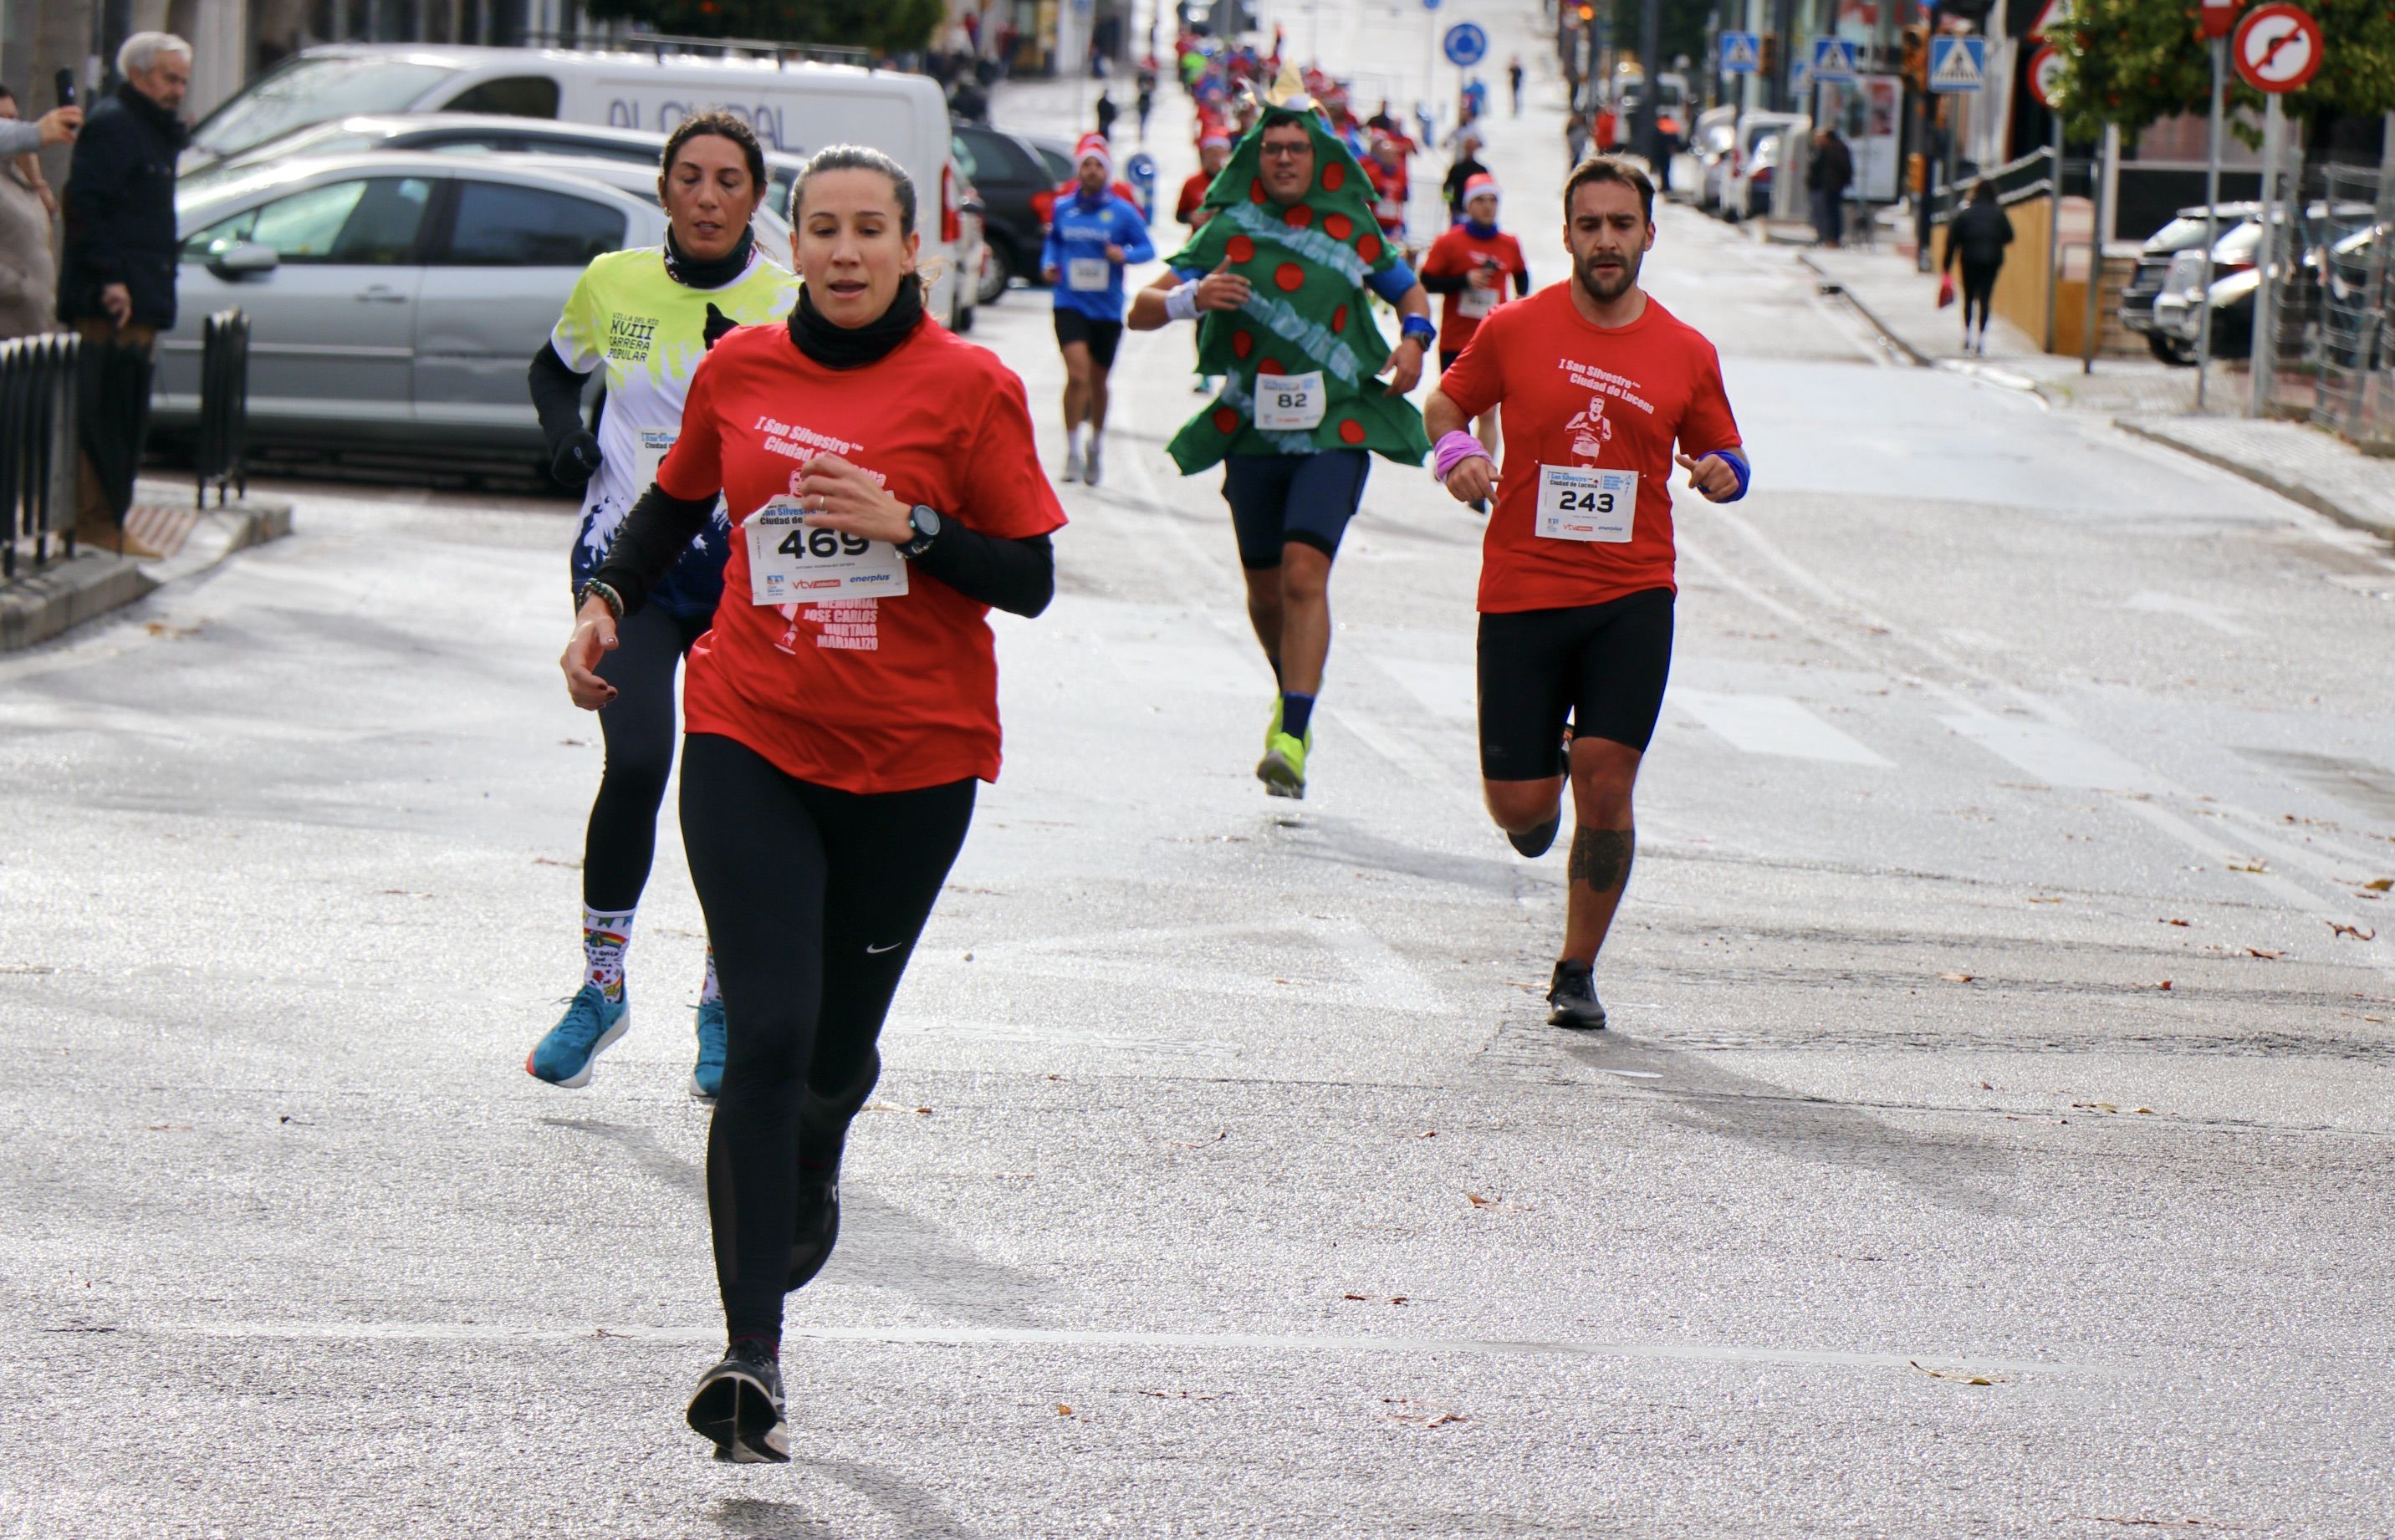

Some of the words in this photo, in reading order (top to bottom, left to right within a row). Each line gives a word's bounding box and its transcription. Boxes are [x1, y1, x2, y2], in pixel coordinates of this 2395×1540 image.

[610, 319, 655, 339] XVIII
[609, 336, 651, 351] CARRERA
[607, 347, 648, 362] POPULAR
[1558, 358, 1566, 369] I
[1565, 360, 1586, 374] San
[1586, 365, 1632, 389] Silvestre
[1278, 394, 1308, 408] 82
[1570, 373, 1607, 392] Ciudad
[1606, 385, 1621, 397] de
[1621, 389, 1655, 415] Lucena
[754, 416, 767, 430] I
[763, 418, 791, 436] San
[789, 426, 850, 456] Silvestre
[763, 436, 815, 462] Ciudad
[1560, 490, 1615, 512] 243
[759, 517, 790, 525] Ciudad
[792, 516, 804, 524] de
[778, 528, 871, 559] 469
[792, 579, 815, 589] vtv
[850, 574, 891, 584] enerplus
[803, 609, 832, 623] JOSE
[834, 609, 878, 624] CARLOS
[824, 623, 878, 637] HURTADO
[816, 635, 879, 650] MARJALIZO
